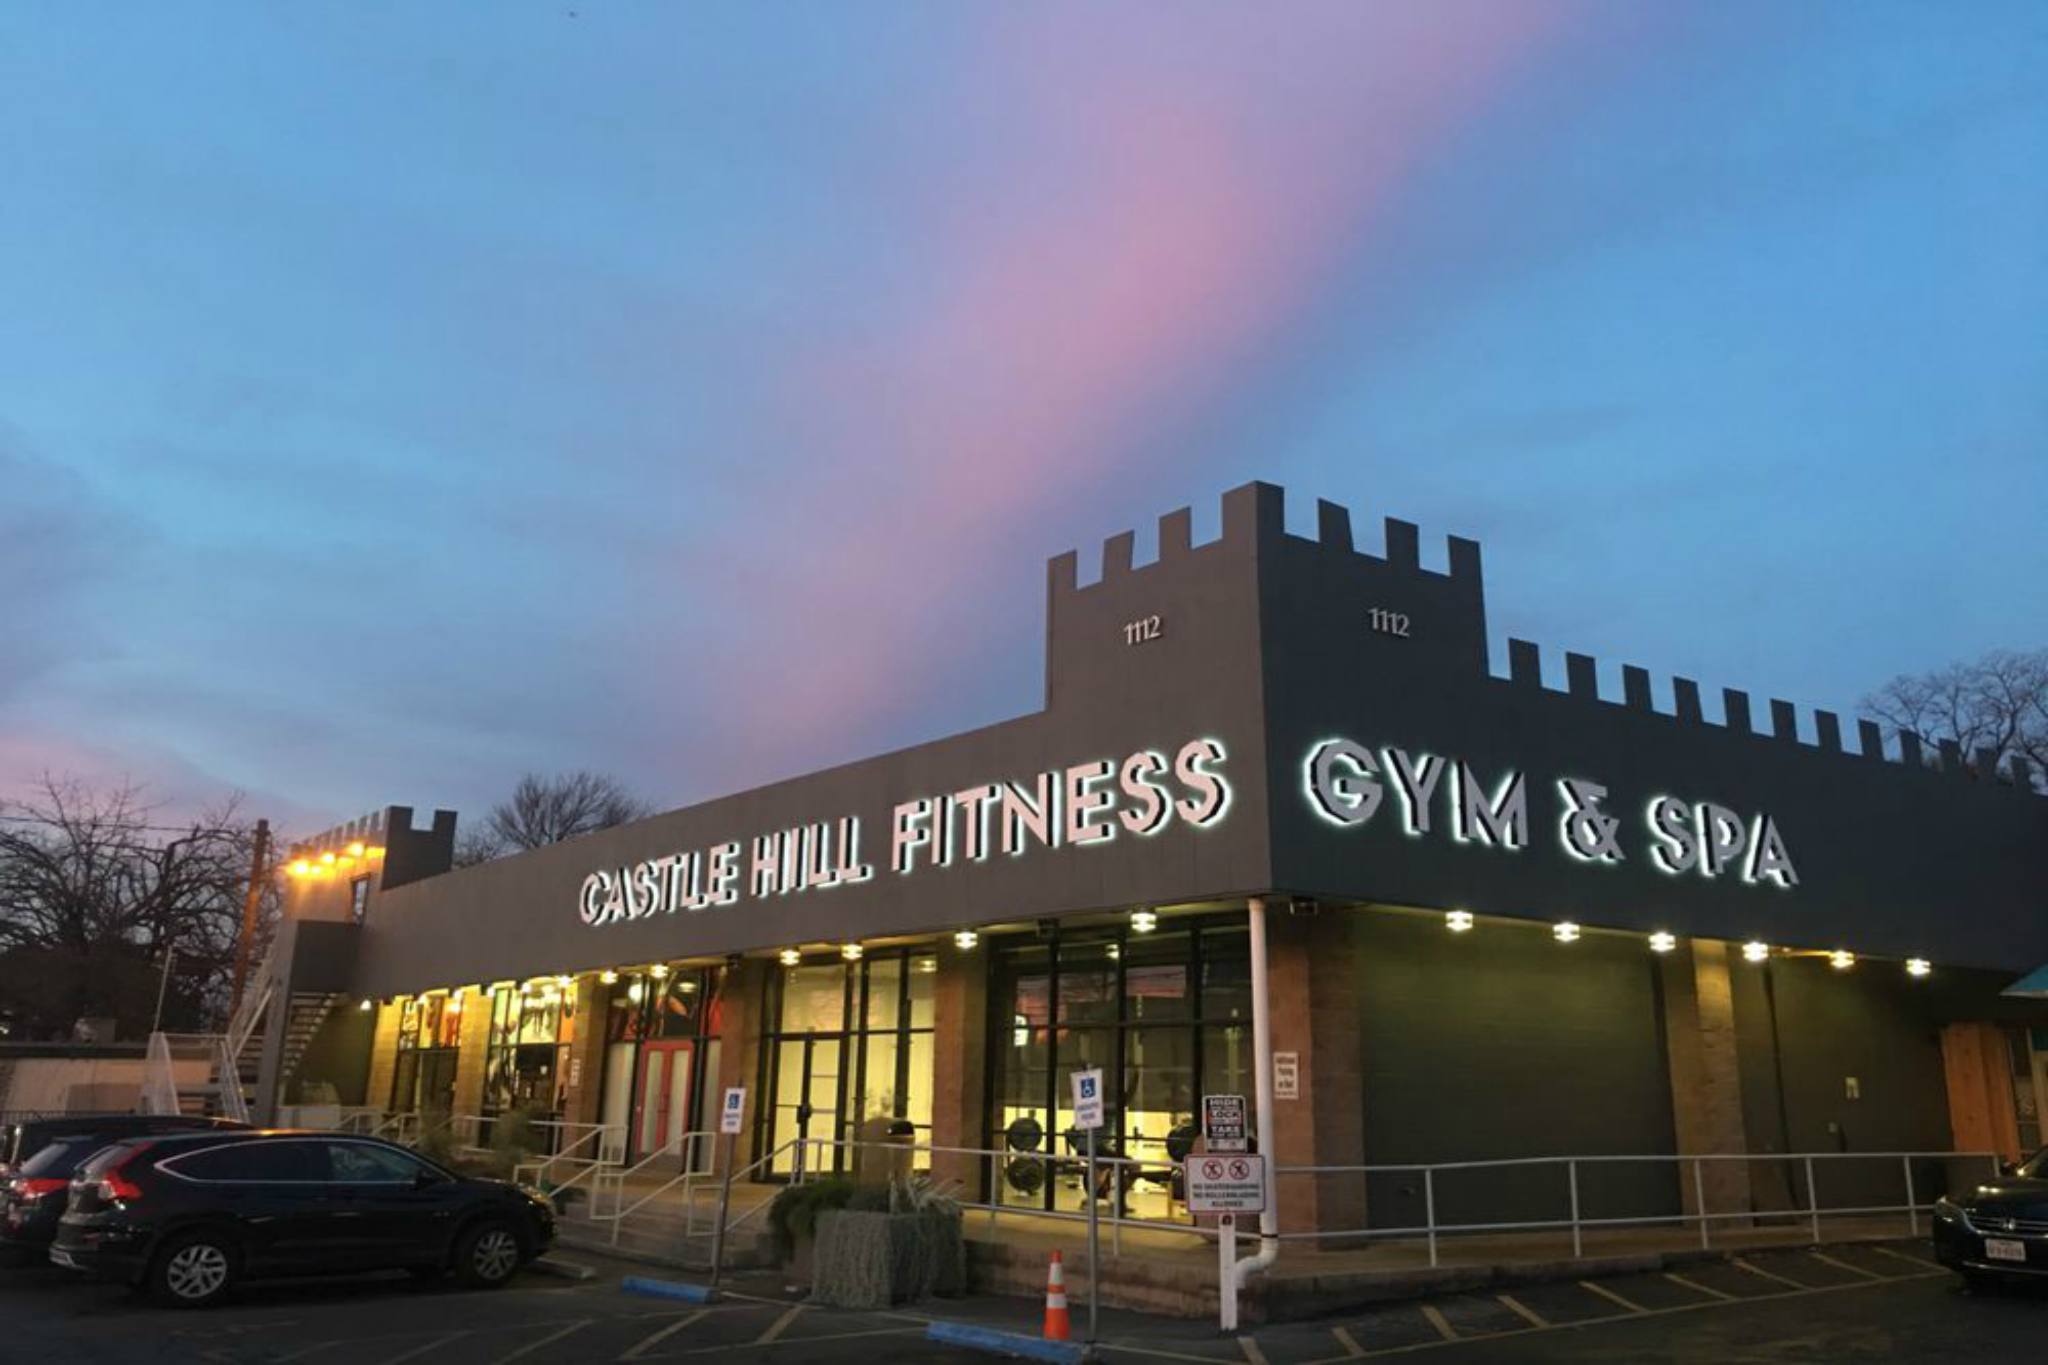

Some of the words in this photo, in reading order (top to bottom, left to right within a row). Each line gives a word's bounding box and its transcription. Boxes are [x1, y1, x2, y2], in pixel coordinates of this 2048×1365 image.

[1123, 614, 1161, 645] 1112
[1367, 607, 1410, 637] 1112
[1303, 738, 1529, 850] GYM
[1556, 777, 1626, 862] &
[1647, 796, 1799, 887] SPA
[579, 841, 740, 926] CASTLE
[751, 815, 874, 898] HILL
[891, 738, 1233, 875] FITNESS
[1210, 1109, 1241, 1119] LOCK
